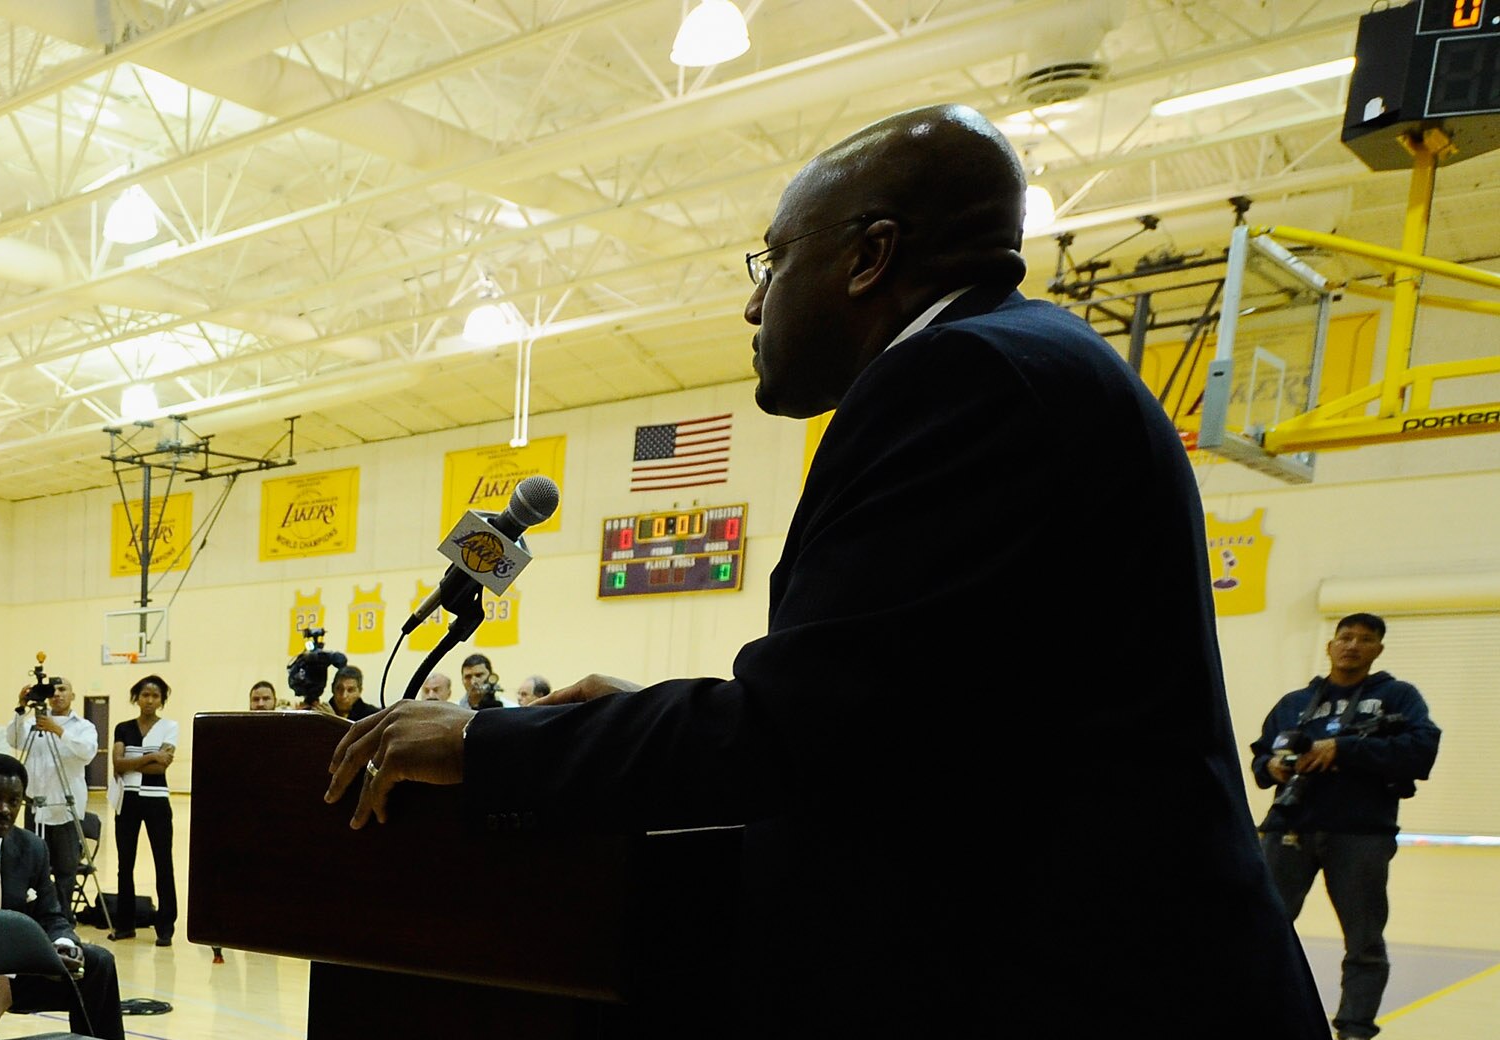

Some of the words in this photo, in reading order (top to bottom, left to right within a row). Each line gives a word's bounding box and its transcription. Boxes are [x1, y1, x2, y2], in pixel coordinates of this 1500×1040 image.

[280, 501, 338, 528] LAKERS
[709, 506, 743, 520] VISITOR
[606, 517, 635, 530] HOME
[452, 530, 516, 579] LAKERS
[485, 600, 509, 621] 33
[296, 613, 316, 632] 22
[357, 611, 376, 631] 13
